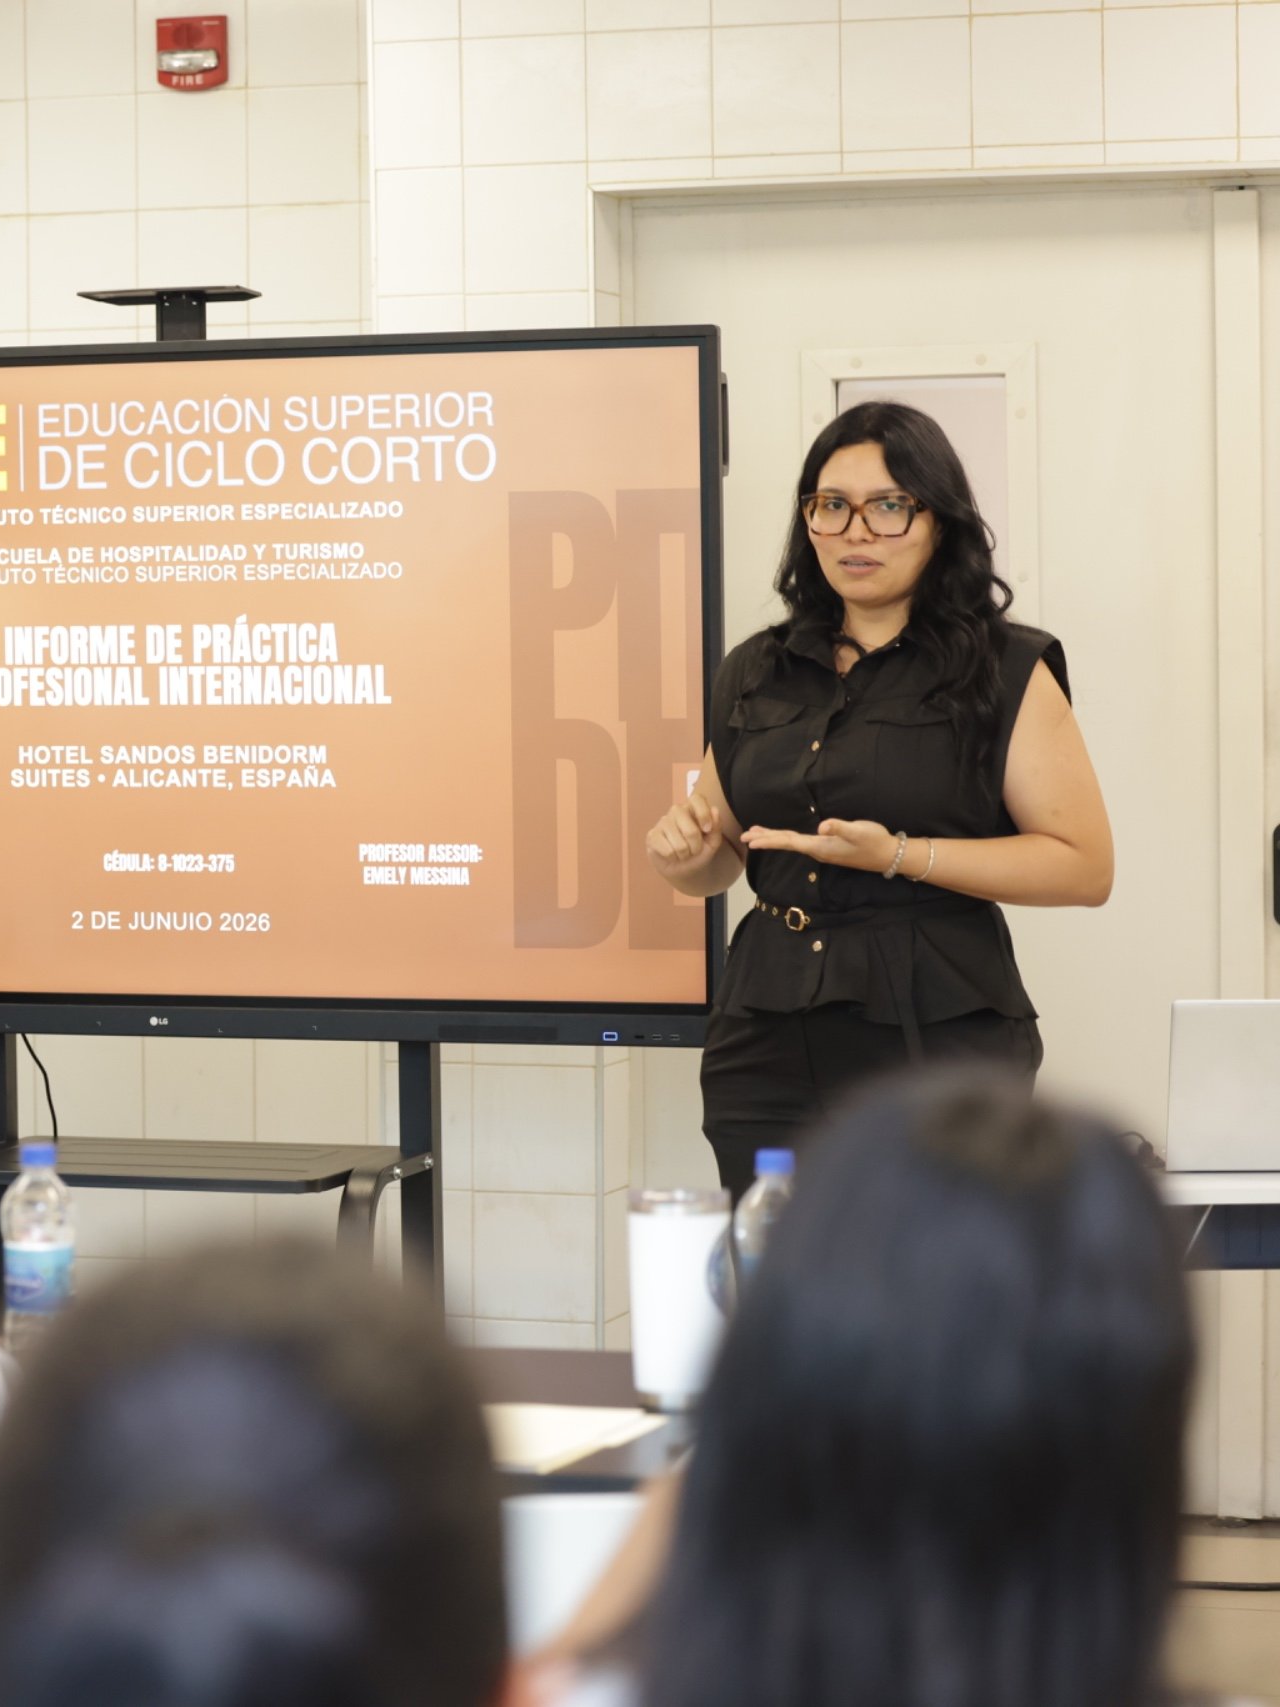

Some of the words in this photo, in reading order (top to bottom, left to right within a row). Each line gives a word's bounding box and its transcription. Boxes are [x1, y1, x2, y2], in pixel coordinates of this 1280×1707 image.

[172, 74, 203, 85] FIRE
[39, 394, 270, 438] EDUCACIÓN
[284, 392, 494, 432] SUPERIOR
[39, 444, 108, 490] DE
[122, 438, 285, 488] CICLO
[302, 434, 497, 484] CORTO
[40, 505, 126, 524] TÉCNICO
[132, 504, 235, 523] SUPERIOR
[241, 501, 403, 520] ESPECIALIZADO
[68, 547, 94, 563] DE
[101, 544, 247, 563] HOSPITALIDAD
[253, 544, 266, 560] Y
[272, 542, 365, 560] TURISMO
[42, 564, 129, 584] TÉCNICO
[135, 564, 237, 582] SUPERIOR
[244, 562, 403, 580] ESPECIALIZADO
[4, 626, 135, 666] INFORME
[146, 625, 181, 664] DE
[193, 615, 338, 664] PRÁCTICA
[159, 664, 391, 706] INTERNACIONAL
[18, 745, 93, 765] HOTEL
[100, 745, 196, 765] SANDOS
[203, 745, 327, 765] BENIDORM
[10, 768, 90, 788] SUITES
[112, 768, 233, 791] ALICANTE,
[241, 764, 337, 788] ESPAÑA
[103, 850, 155, 872] CÉDULA:
[158, 854, 235, 873] 8-1023-375
[359, 844, 425, 862] PROFESOR
[428, 844, 483, 863] ASESOR:
[363, 866, 407, 885] EMELY
[410, 866, 470, 886] MESSINA
[71, 910, 84, 930] 2
[91, 910, 121, 930] DE
[128, 911, 213, 931] JUNUIO
[219, 912, 271, 932] 2026
